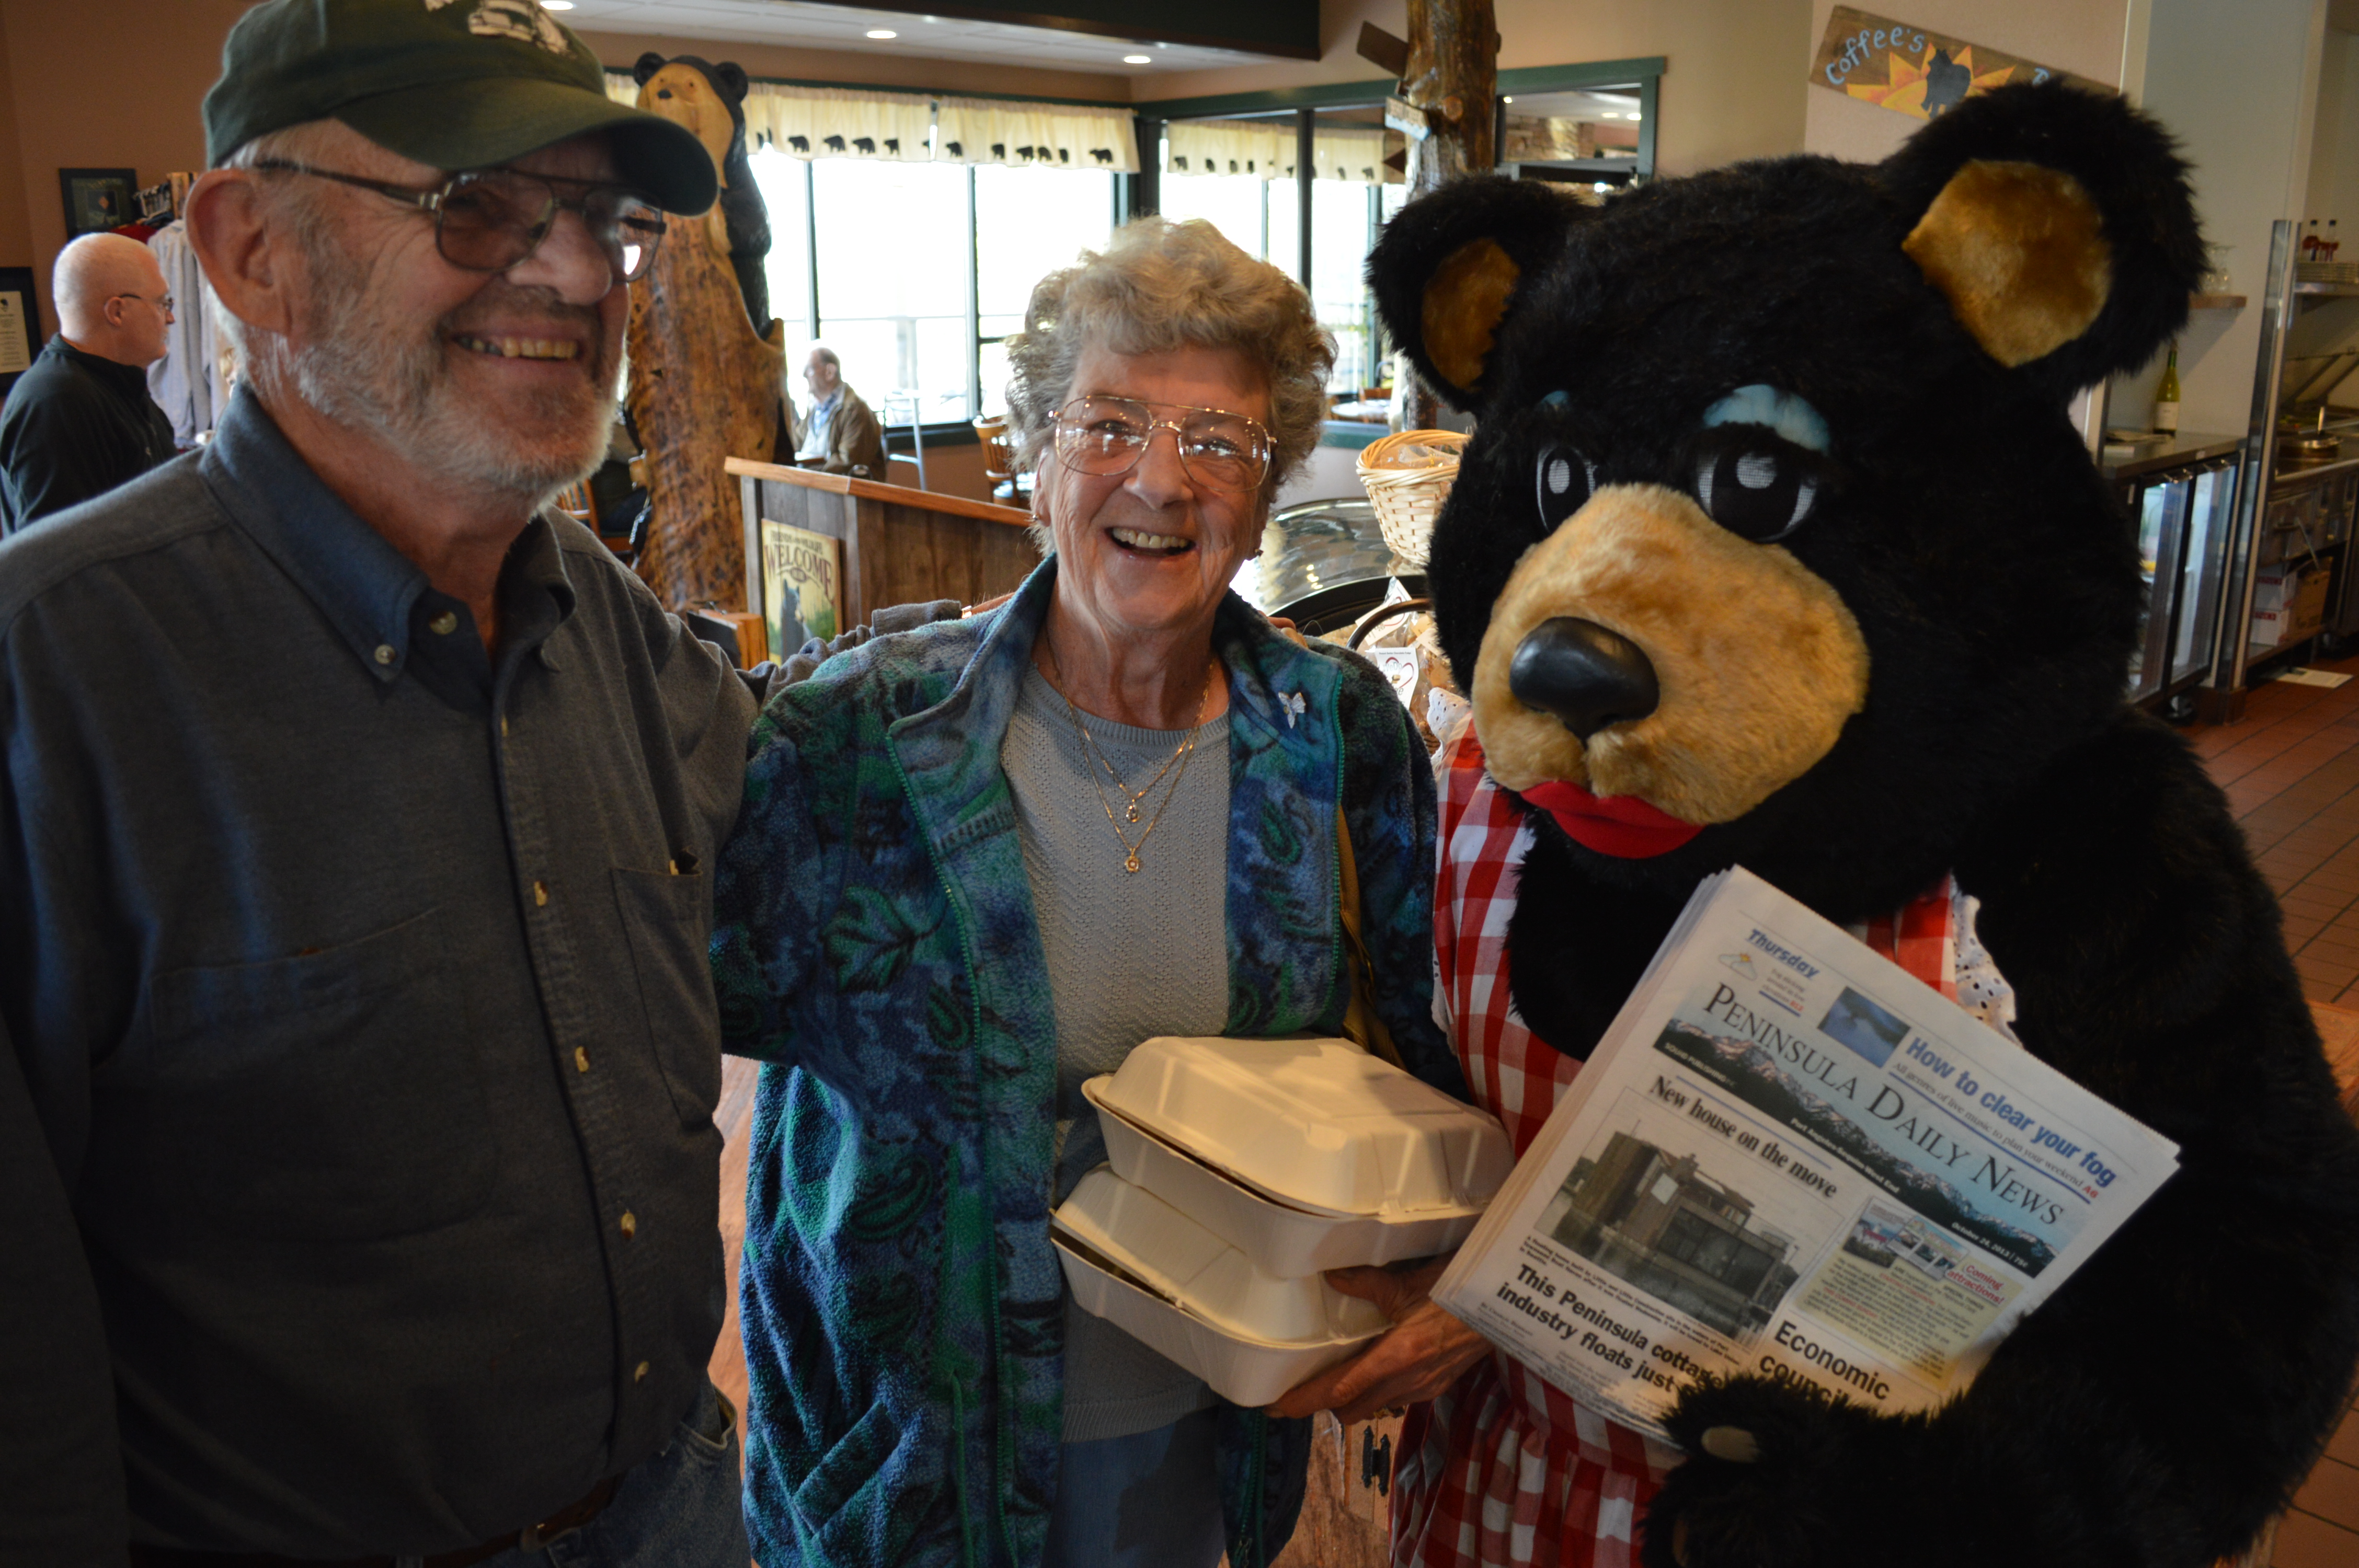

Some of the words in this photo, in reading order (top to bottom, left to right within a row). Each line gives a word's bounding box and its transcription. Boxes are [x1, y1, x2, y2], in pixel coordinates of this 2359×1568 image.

[1825, 26, 1926, 86] Coffee's
[763, 544, 835, 599] WELCOME
[1748, 929, 1819, 978] Thursday
[1651, 1076, 1686, 1108] New
[1689, 1098, 1736, 1137] house
[1737, 1132, 1759, 1151] on
[1760, 1143, 1788, 1168] the
[1788, 1162, 1836, 1197] move
[1893, 1063, 1908, 1074] All
[1903, 1072, 1936, 1093] genres
[1937, 1093, 1951, 1104] of
[1948, 1098, 1964, 1113] live
[1964, 1112, 1991, 1132] music
[1992, 1129, 2002, 1139] to
[1999, 1137, 2023, 1157] plan
[2020, 1149, 2044, 1169] your
[2045, 1161, 2084, 1187] weekend
[2083, 1186, 2098, 1198] A6
[1906, 1037, 1955, 1078] How
[1955, 1071, 1978, 1096] to
[1980, 1093, 2035, 1131] clear
[2031, 1127, 2081, 1158] your
[2080, 1152, 2116, 1187] fog
[1791, 1118, 1807, 1131] Port
[1884, 1180, 1899, 1193] End
[1952, 1223, 1979, 1240] October
[1991, 1244, 2010, 1256] 2013
[1518, 1264, 1555, 1297] This
[1559, 1290, 1648, 1351] Peninsula
[1946, 1270, 2004, 1306] attractions!
[1966, 1266, 2003, 1291] Coming
[1497, 1282, 1577, 1340] industry
[1581, 1332, 1633, 1370] floats
[1631, 1360, 1675, 1392] just
[1774, 1321, 1897, 1406] Economic
